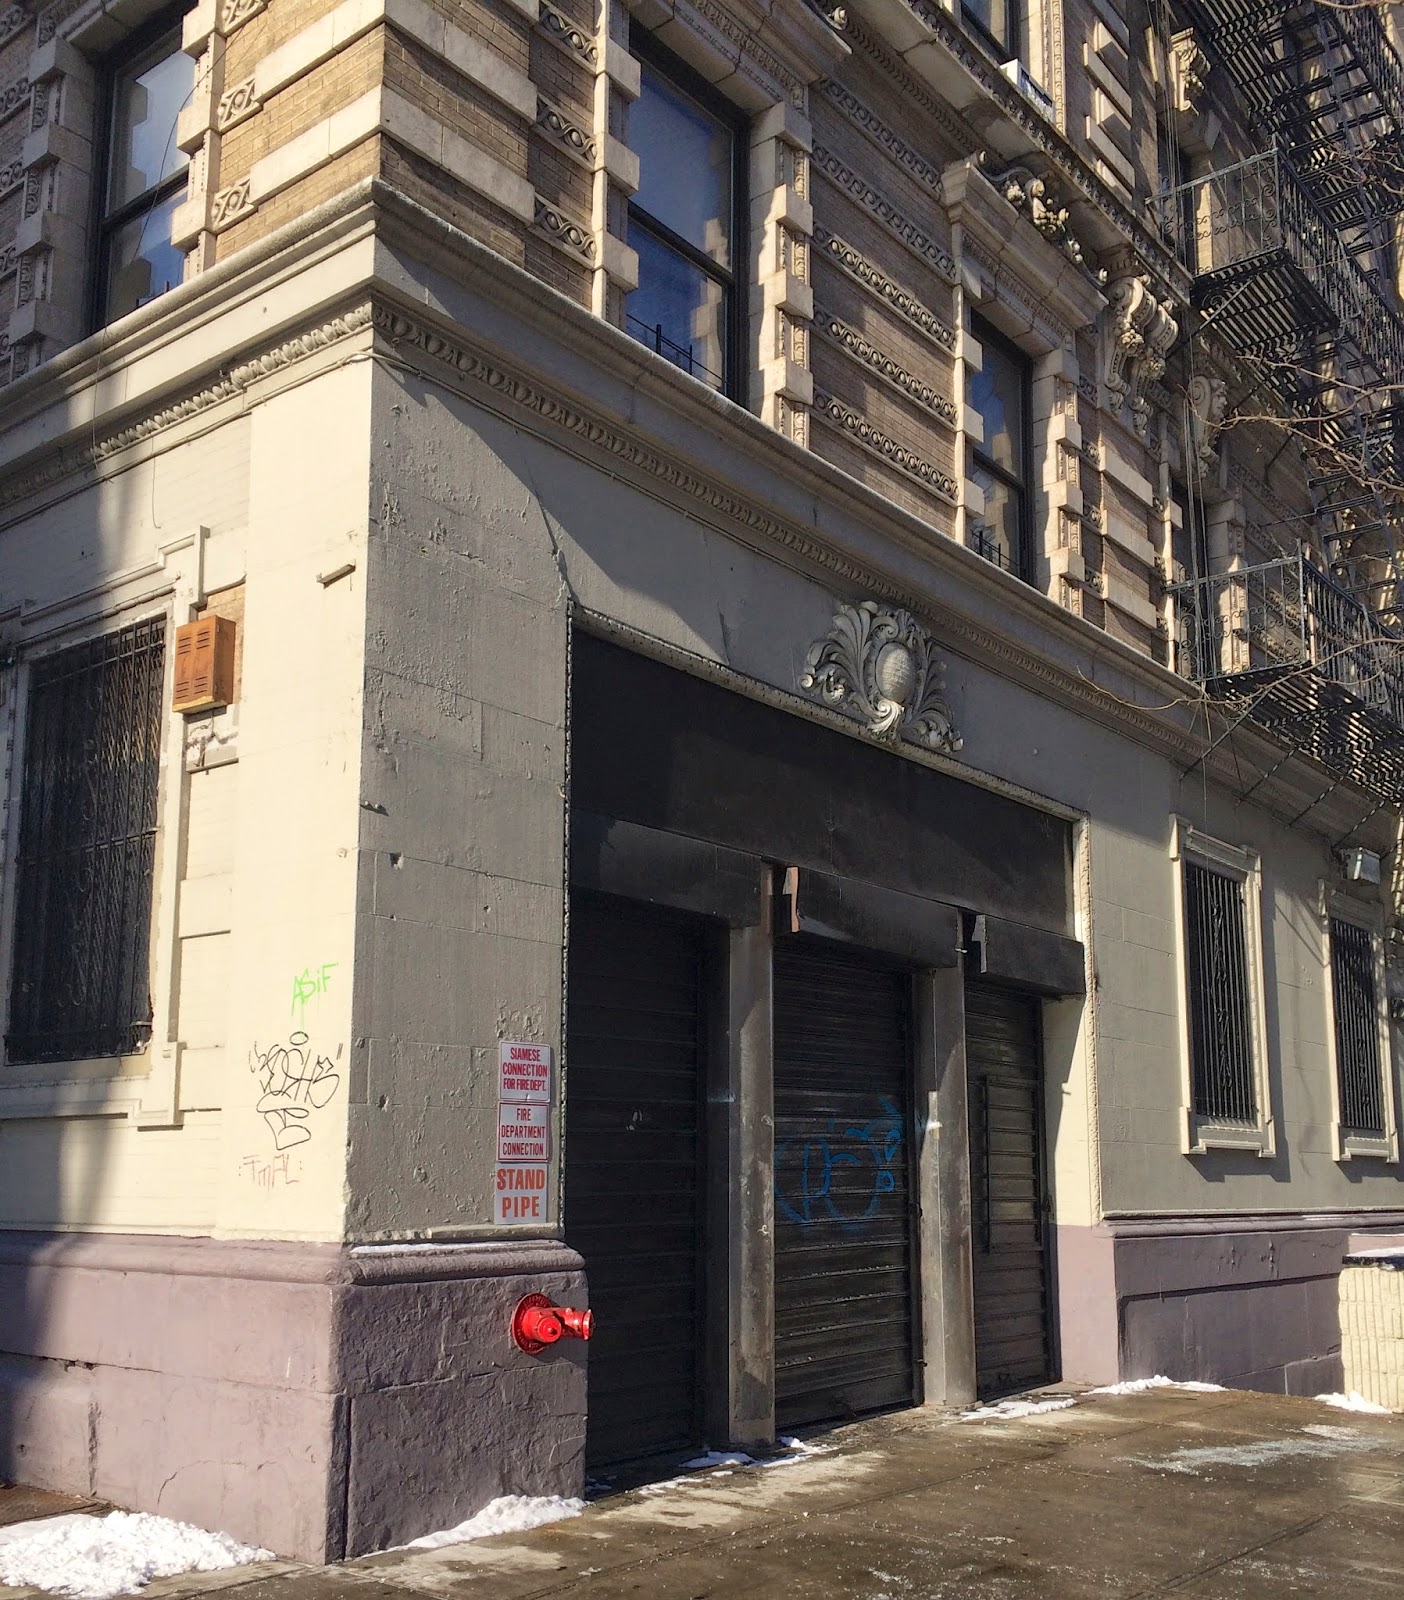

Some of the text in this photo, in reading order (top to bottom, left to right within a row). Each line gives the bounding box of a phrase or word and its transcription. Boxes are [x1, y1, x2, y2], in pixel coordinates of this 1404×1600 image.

[510, 1047, 541, 1062] SIAMESE
[502, 1062, 548, 1077] CONNECTION
[503, 1078, 515, 1090] FOR
[516, 1079, 530, 1091] FIRE
[516, 1108, 531, 1122] FIRE
[501, 1125, 545, 1139] DEPARTMENT
[502, 1142, 544, 1156] CONNECTION
[497, 1169, 545, 1190] STAND
[502, 1196, 540, 1218] PIPE
